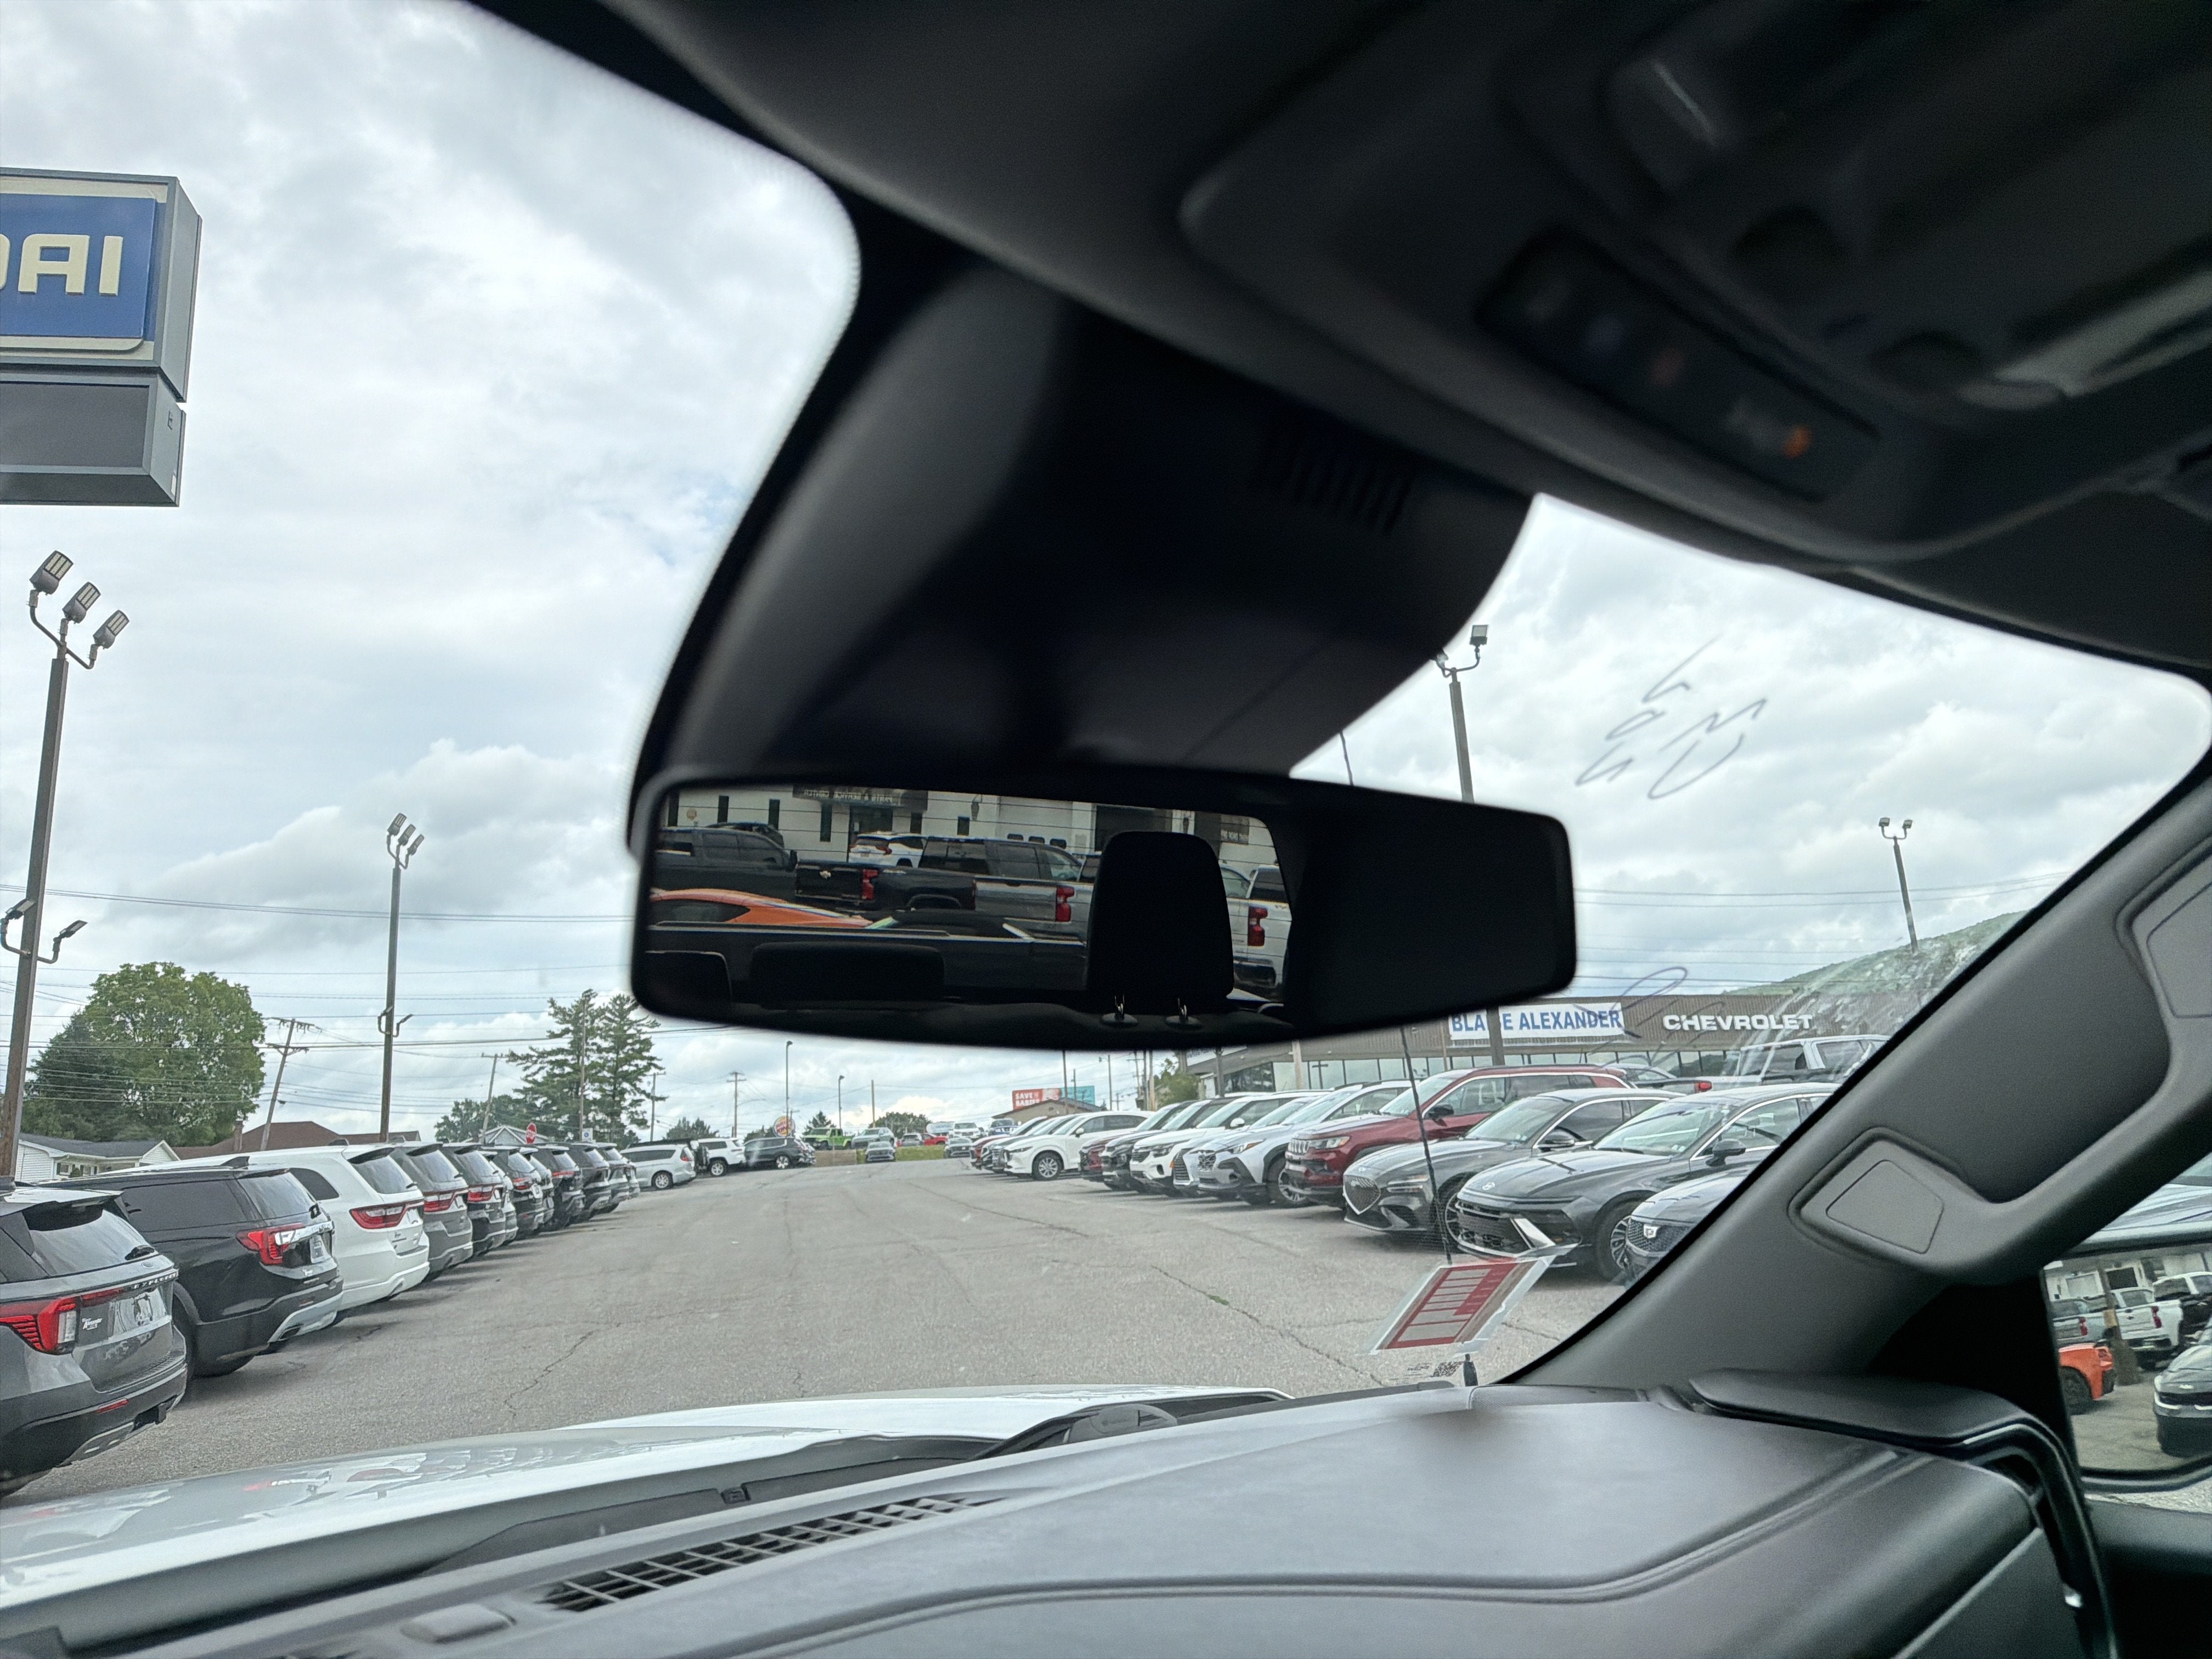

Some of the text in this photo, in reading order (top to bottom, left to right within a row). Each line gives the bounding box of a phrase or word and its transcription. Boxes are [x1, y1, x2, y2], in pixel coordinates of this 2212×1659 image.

[0, 234, 123, 296] AI
[1452, 1010, 1622, 1032] BLAE ALEXANDER
[1663, 1014, 1813, 1030] CHEVROLET
